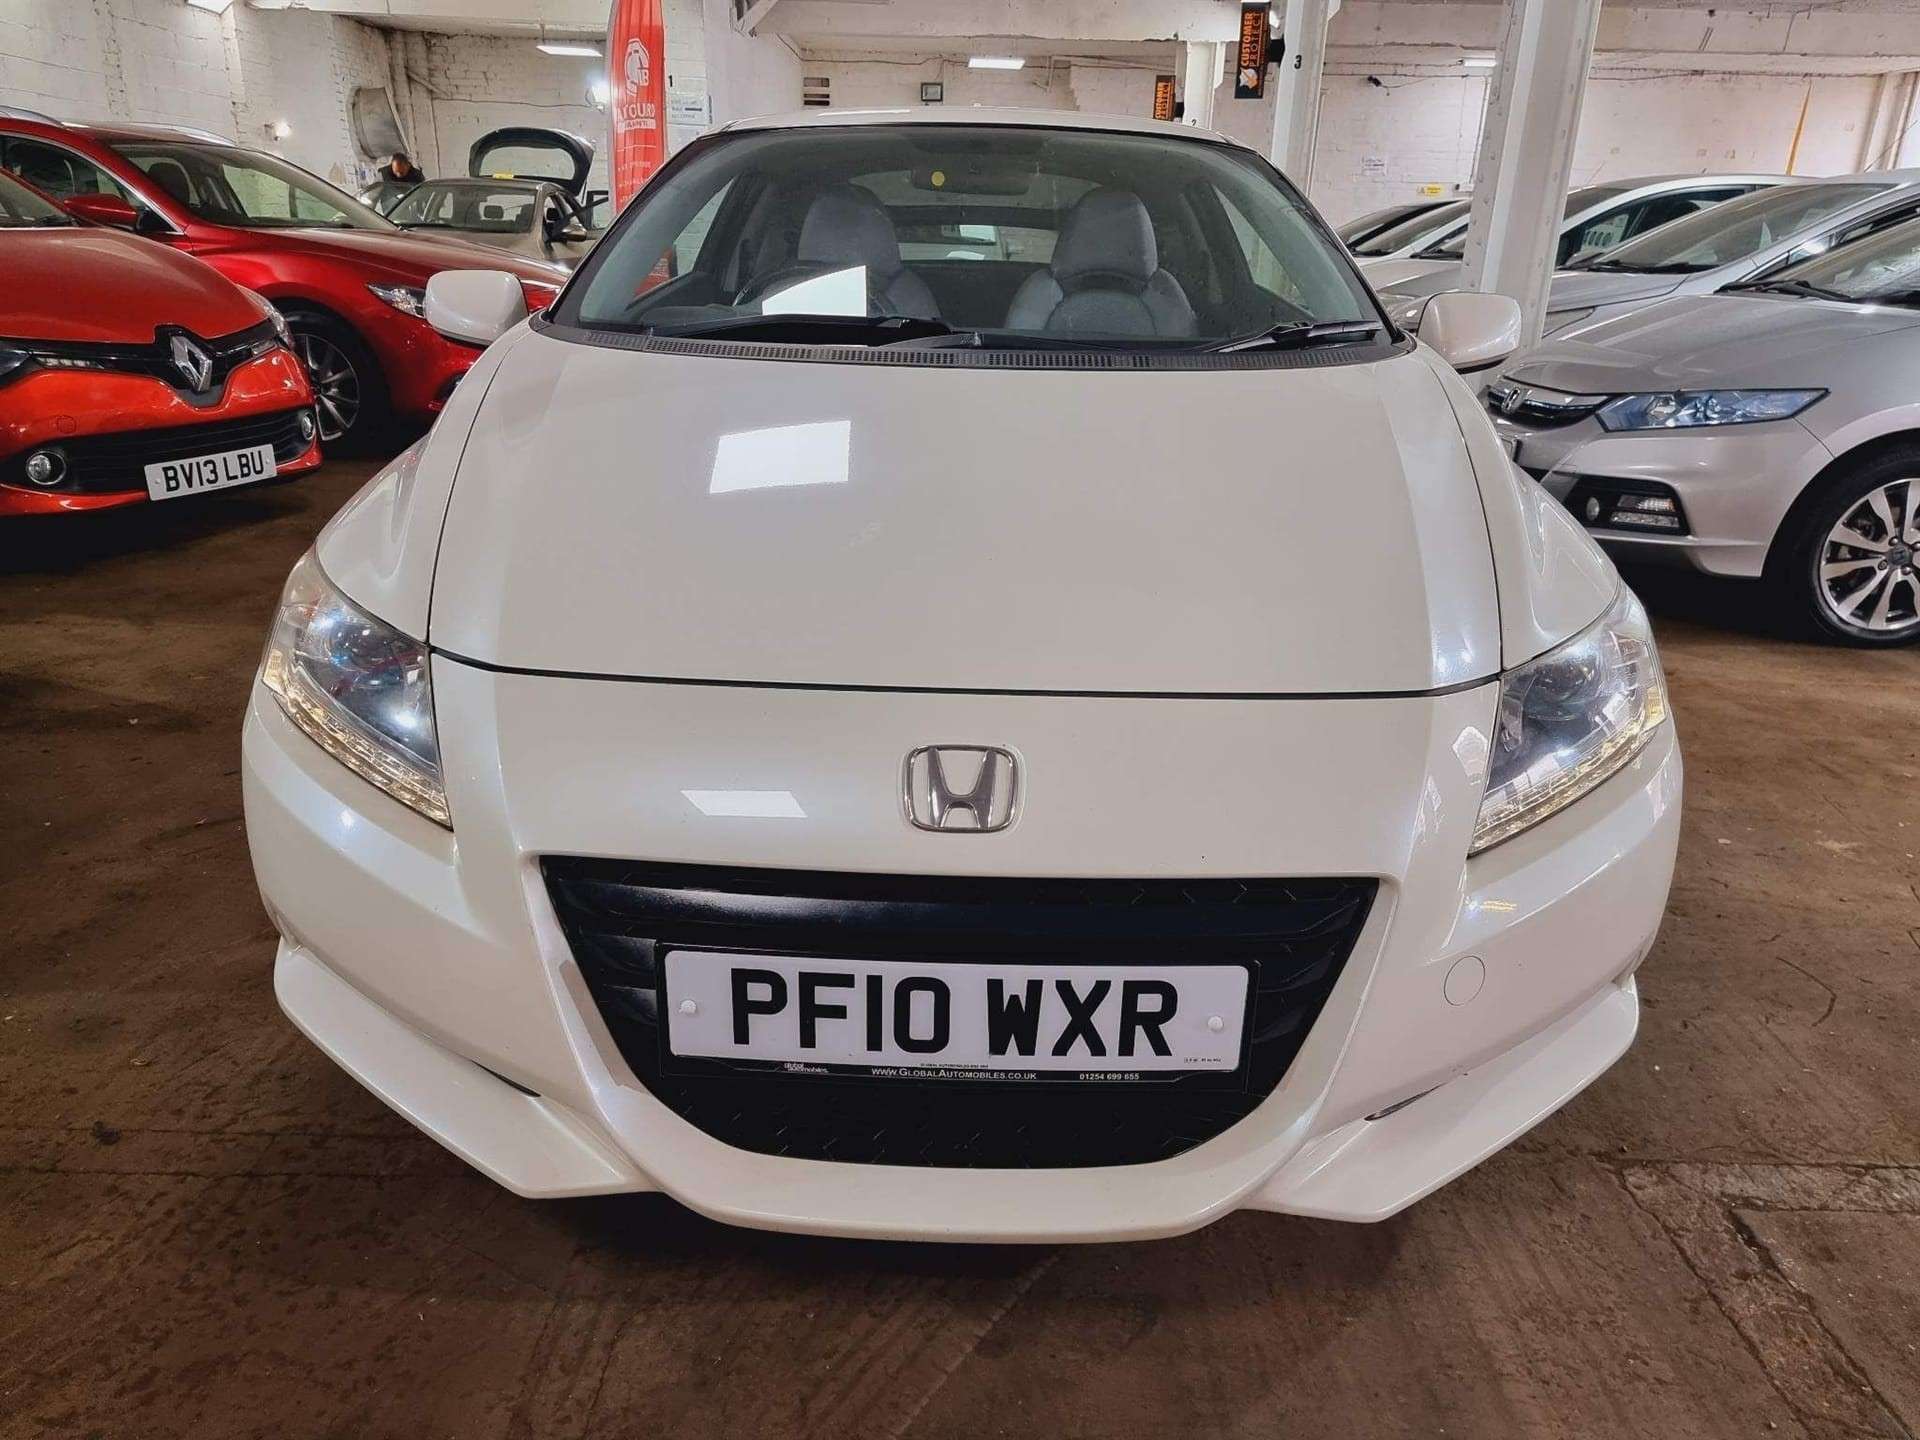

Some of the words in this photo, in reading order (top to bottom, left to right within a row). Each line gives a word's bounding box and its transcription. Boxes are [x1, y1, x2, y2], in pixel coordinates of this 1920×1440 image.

[1240, 12, 1253, 67] CUSTOMER
[1249, 12, 1260, 67] PROTECT
[1294, 54, 1302, 69] 3
[162, 459, 219, 492] BV13
[222, 450, 264, 481] LBU
[730, 967, 952, 1054] PF10
[986, 978, 1178, 1057] WXR
[1079, 1073, 1105, 1081] 01254
